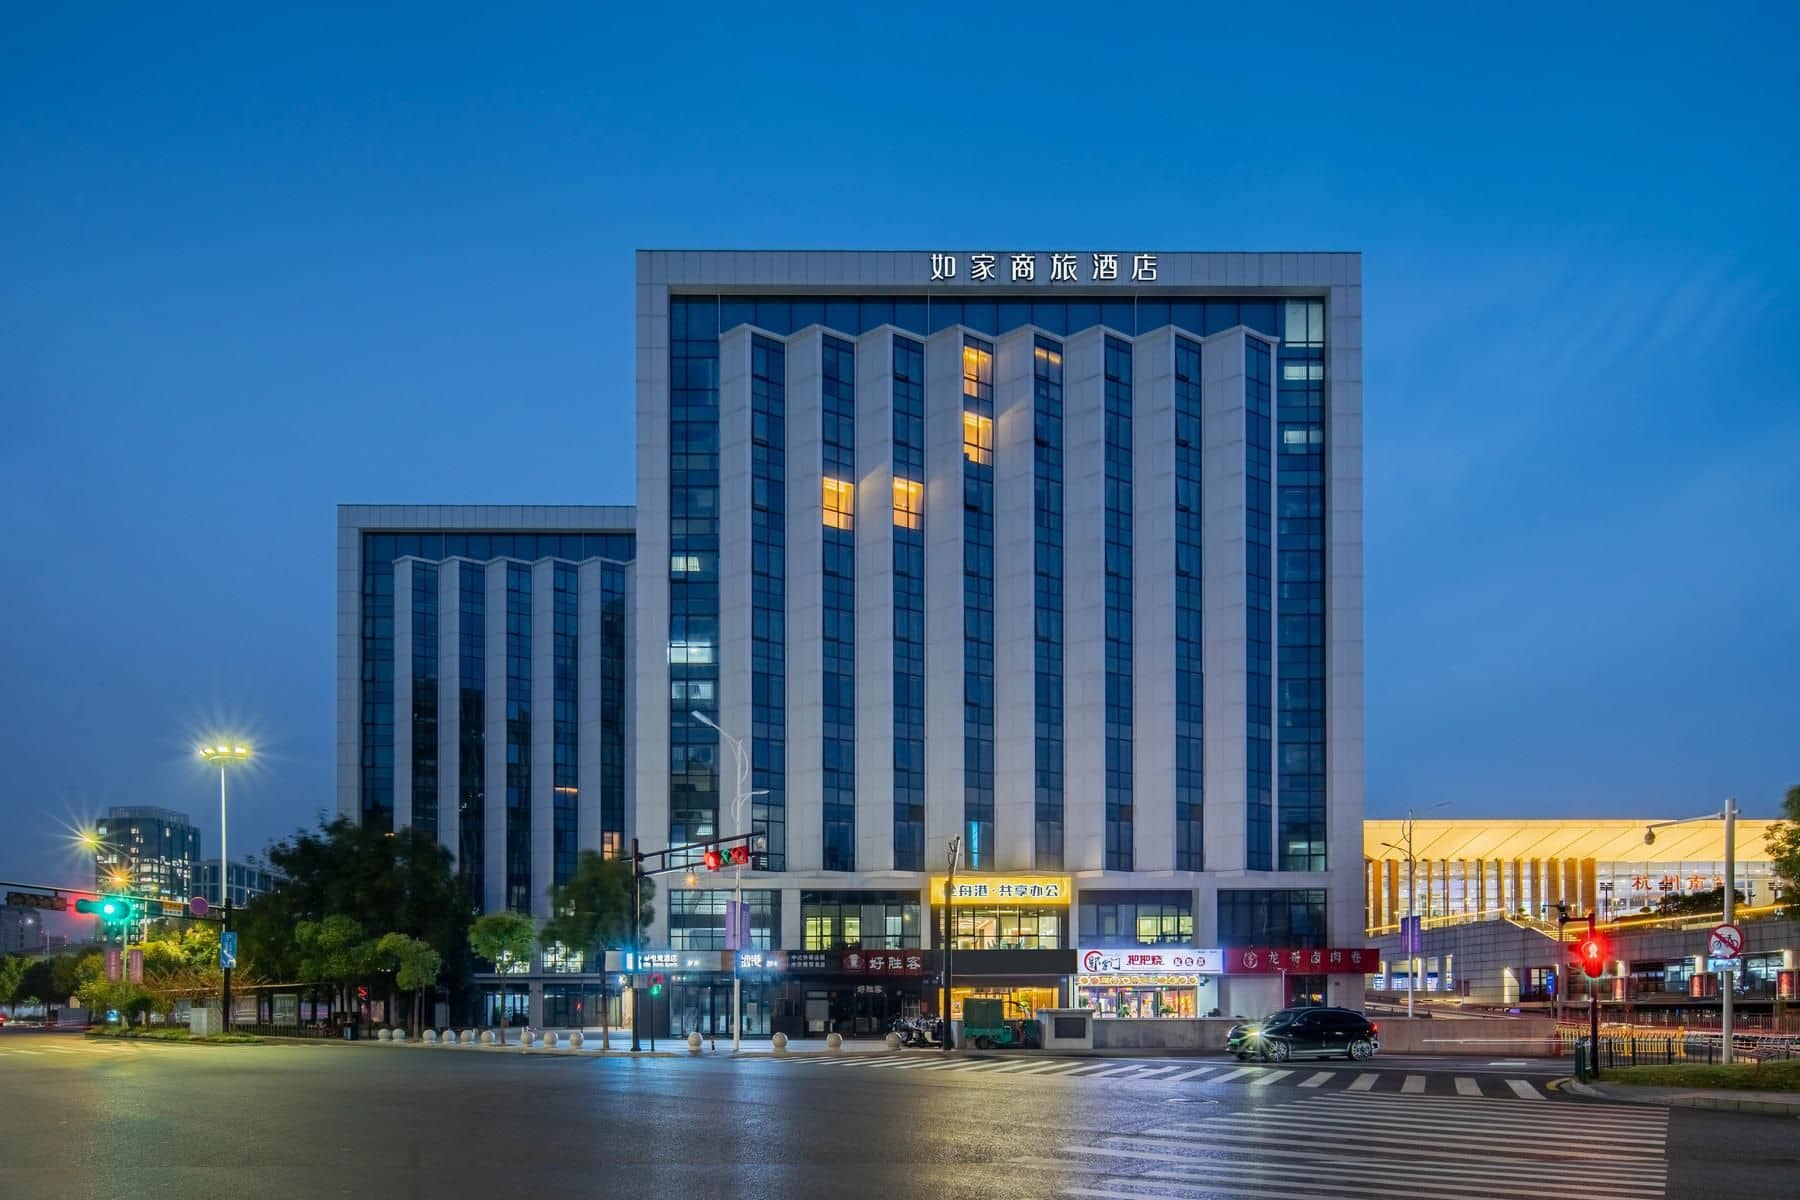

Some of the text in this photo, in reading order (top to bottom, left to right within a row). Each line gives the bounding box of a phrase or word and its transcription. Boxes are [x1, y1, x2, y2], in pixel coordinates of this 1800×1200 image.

[930, 253, 1158, 281] 如家商旅酒店
[869, 955, 921, 970] 好胜客
